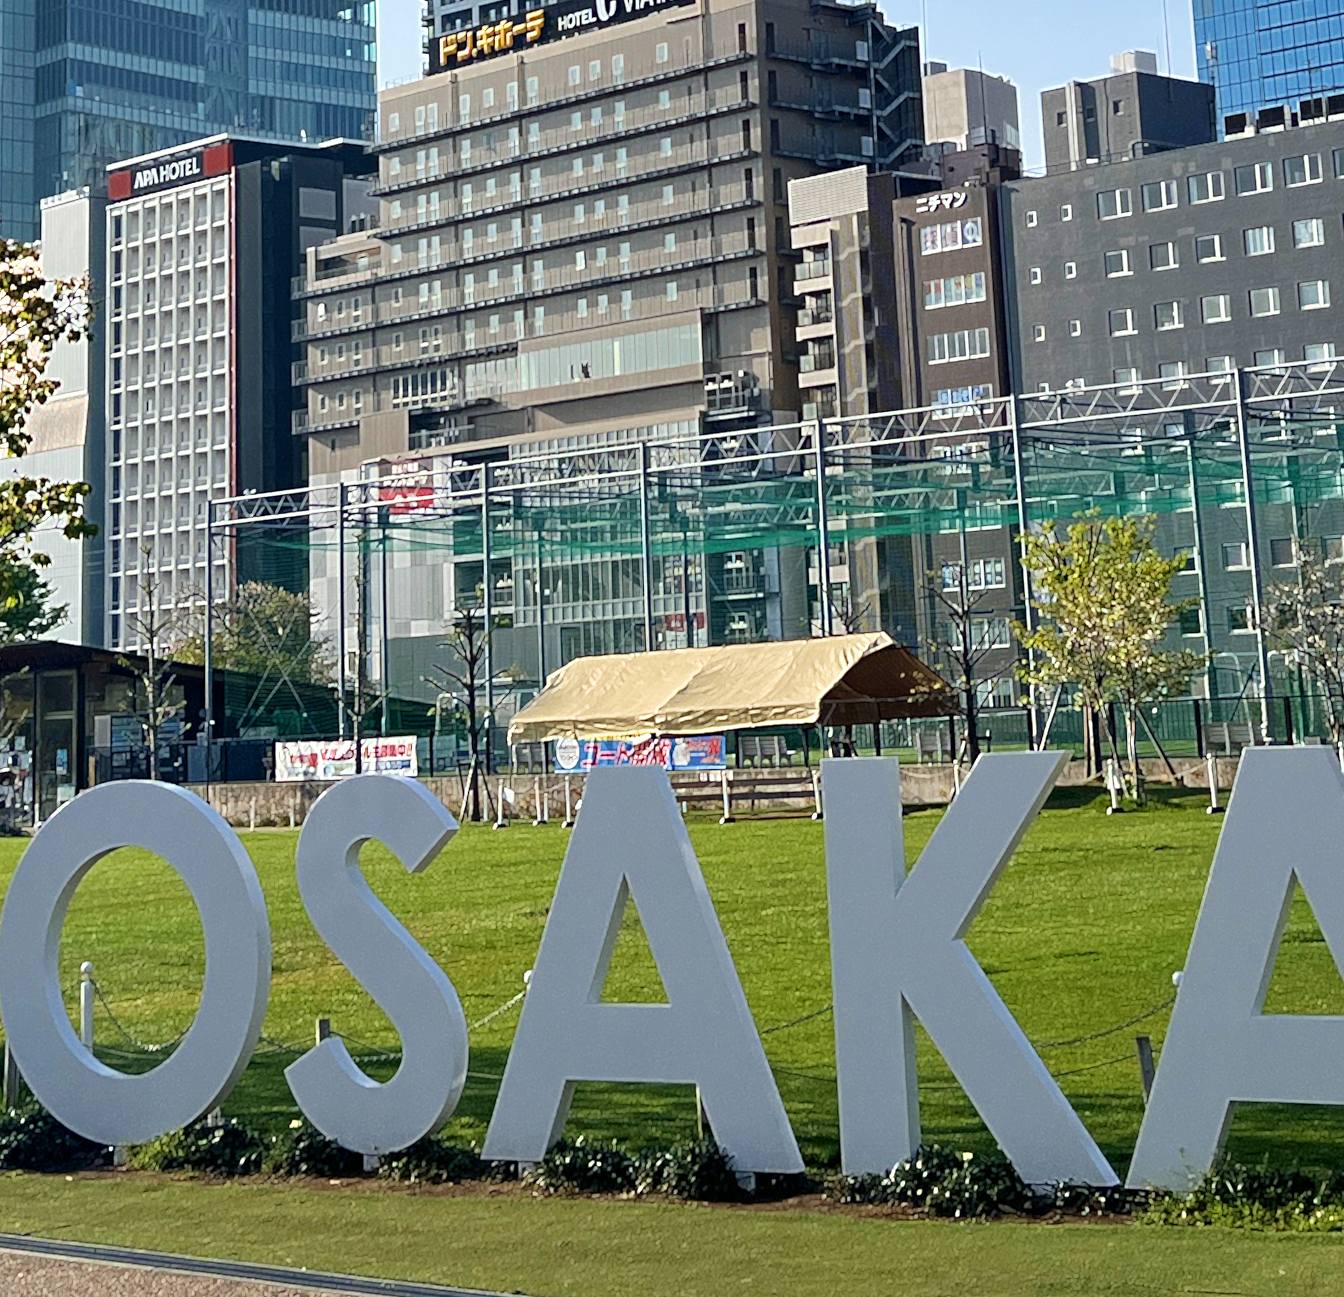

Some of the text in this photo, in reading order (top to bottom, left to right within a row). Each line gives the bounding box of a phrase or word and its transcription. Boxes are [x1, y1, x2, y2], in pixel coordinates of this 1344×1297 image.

[557, 7, 597, 32] HOTEL
[133, 156, 201, 190] APA HOTEL
[916, 191, 966, 213] ニチマン
